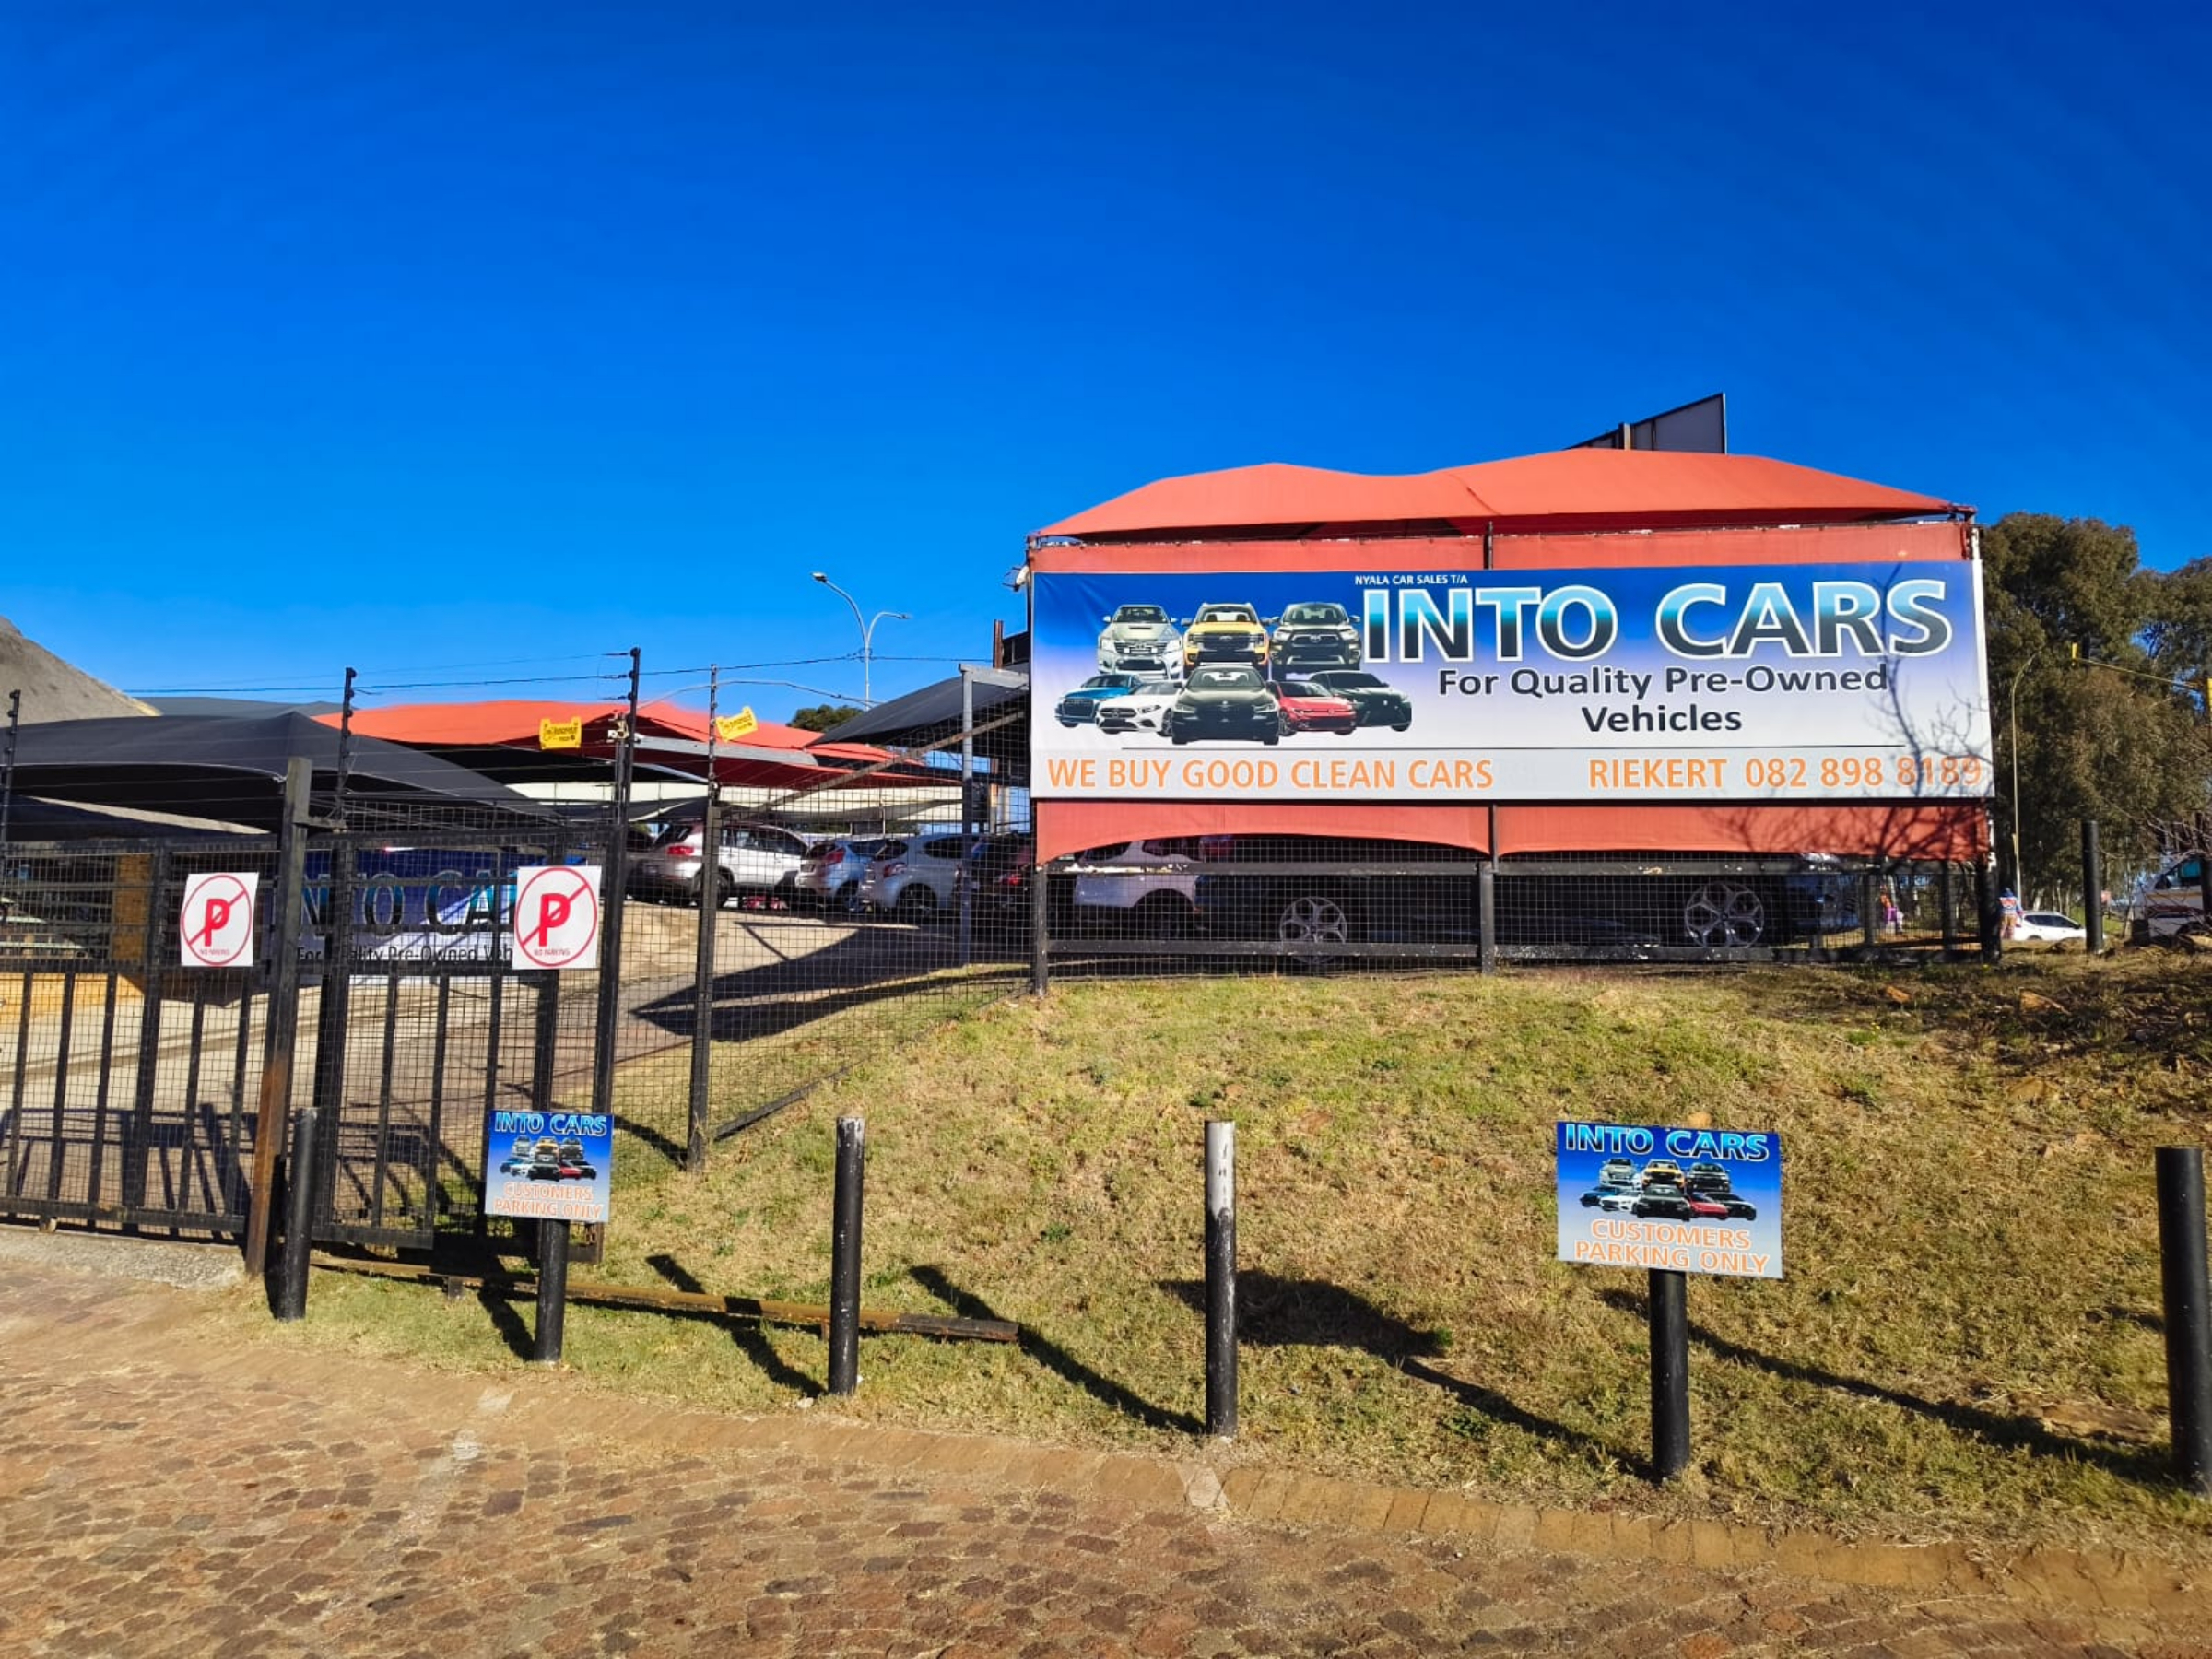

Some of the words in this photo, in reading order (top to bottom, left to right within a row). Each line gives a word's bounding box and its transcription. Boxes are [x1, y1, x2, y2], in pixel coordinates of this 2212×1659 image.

[1355, 575, 1389, 585] NYALA
[1393, 575, 1413, 584] CAR
[1417, 575, 1448, 584] SALES
[1451, 574, 1468, 584] T/A
[1364, 587, 1618, 662] INTO
[1655, 580, 1953, 659] CARS
[1439, 670, 1499, 696] For
[1511, 666, 1653, 700] Quality
[1665, 663, 1889, 693] Pre-Owned
[1582, 704, 1743, 732] Vehicles
[1047, 759, 1097, 788] WE
[1109, 759, 1171, 788] BUY
[1182, 759, 1278, 788] GOOD
[1291, 759, 1394, 788] CLEAN
[1408, 759, 1494, 788] CARS
[1589, 759, 1727, 787] RIEKERT
[1745, 758, 1807, 788] 082
[1819, 757, 1883, 787] 898
[1897, 756, 1982, 786] 8189
[495, 1112, 544, 1133] INTO
[550, 1114, 606, 1136] CARS
[1566, 1124, 1654, 1154] INTO
[1665, 1130, 1770, 1162] CARS
[504, 1182, 593, 1201] CUSTOMERS
[493, 1199, 557, 1216] PARKING
[563, 1203, 605, 1220] ONLY
[1592, 1219, 1751, 1249] CUSTOMERS
[1575, 1240, 1688, 1267] PARKING
[1700, 1250, 1770, 1275] ONLY
